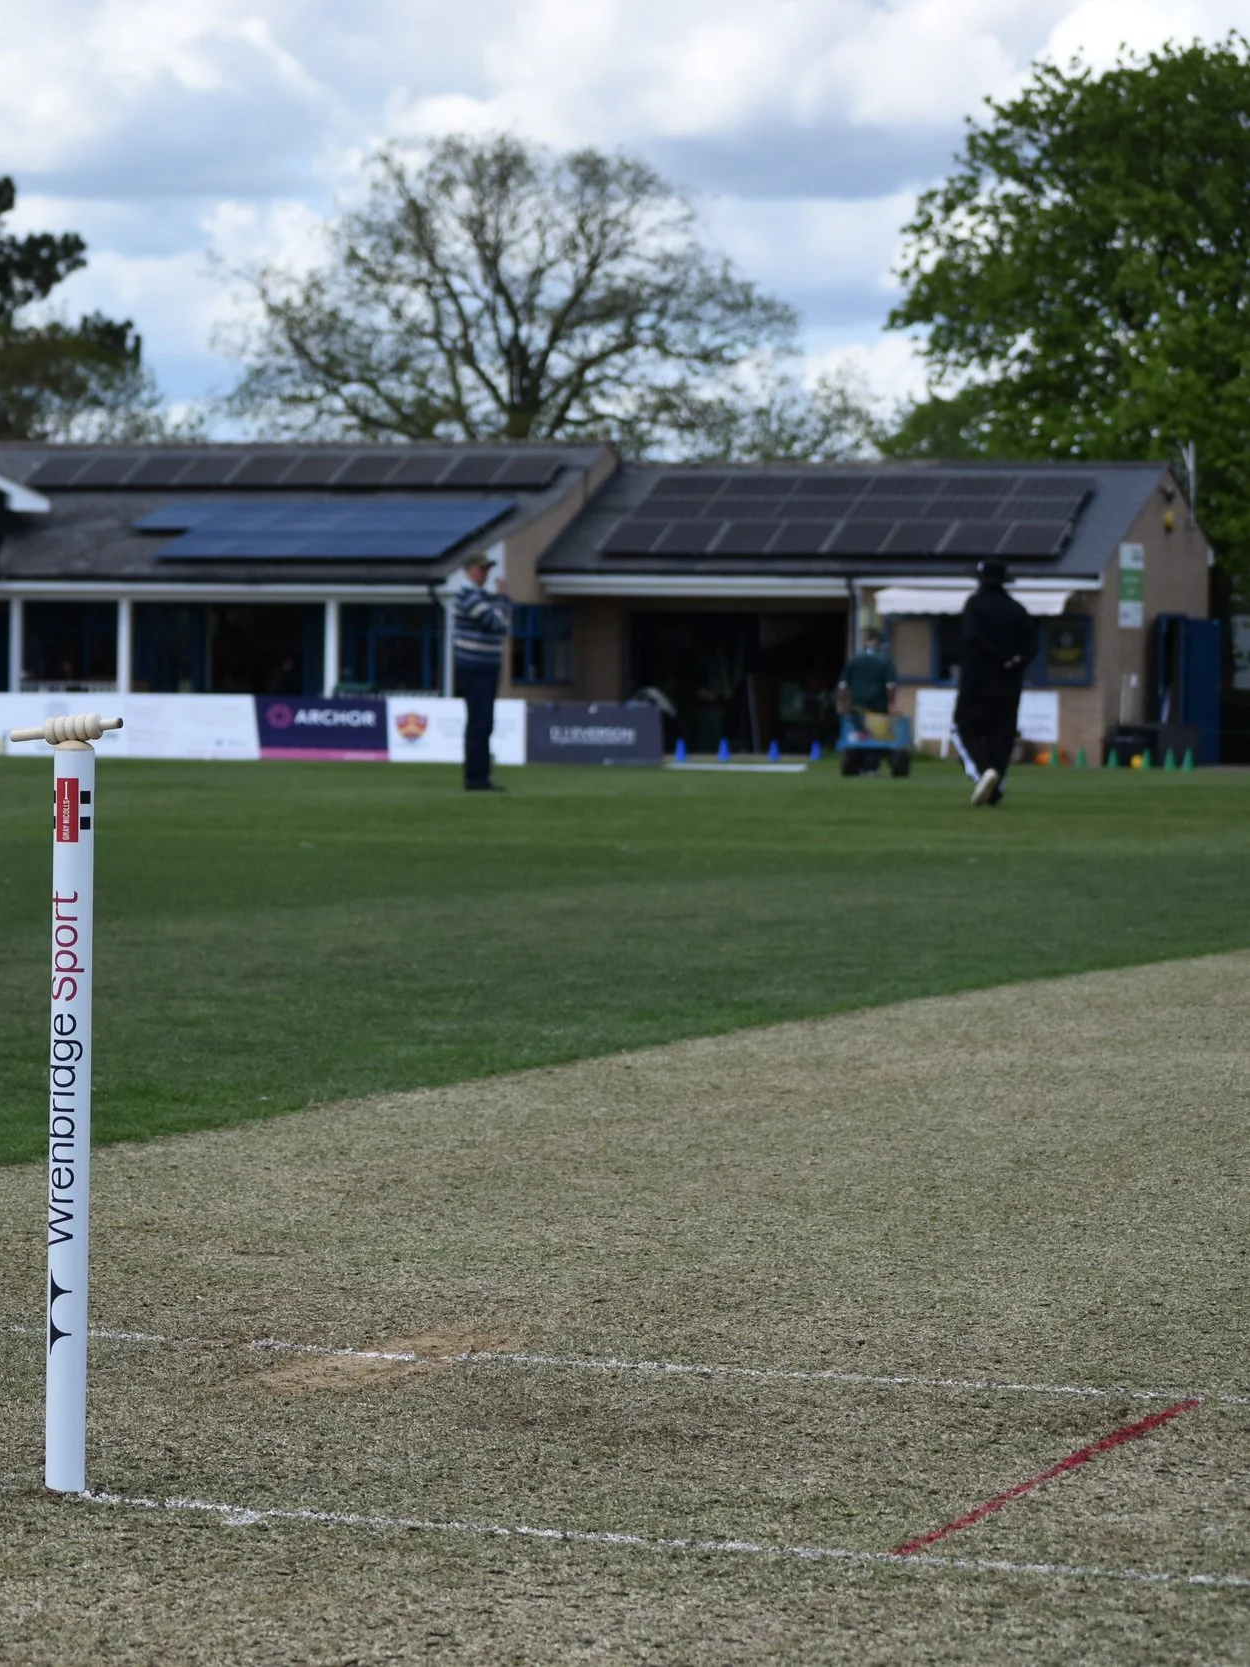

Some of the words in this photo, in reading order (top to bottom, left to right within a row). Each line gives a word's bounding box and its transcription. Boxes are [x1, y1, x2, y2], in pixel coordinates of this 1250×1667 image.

[294, 708, 377, 727] ARCHOR
[51, 890, 85, 1002] Sport
[48, 1013, 83, 1246] Wrenbridge
